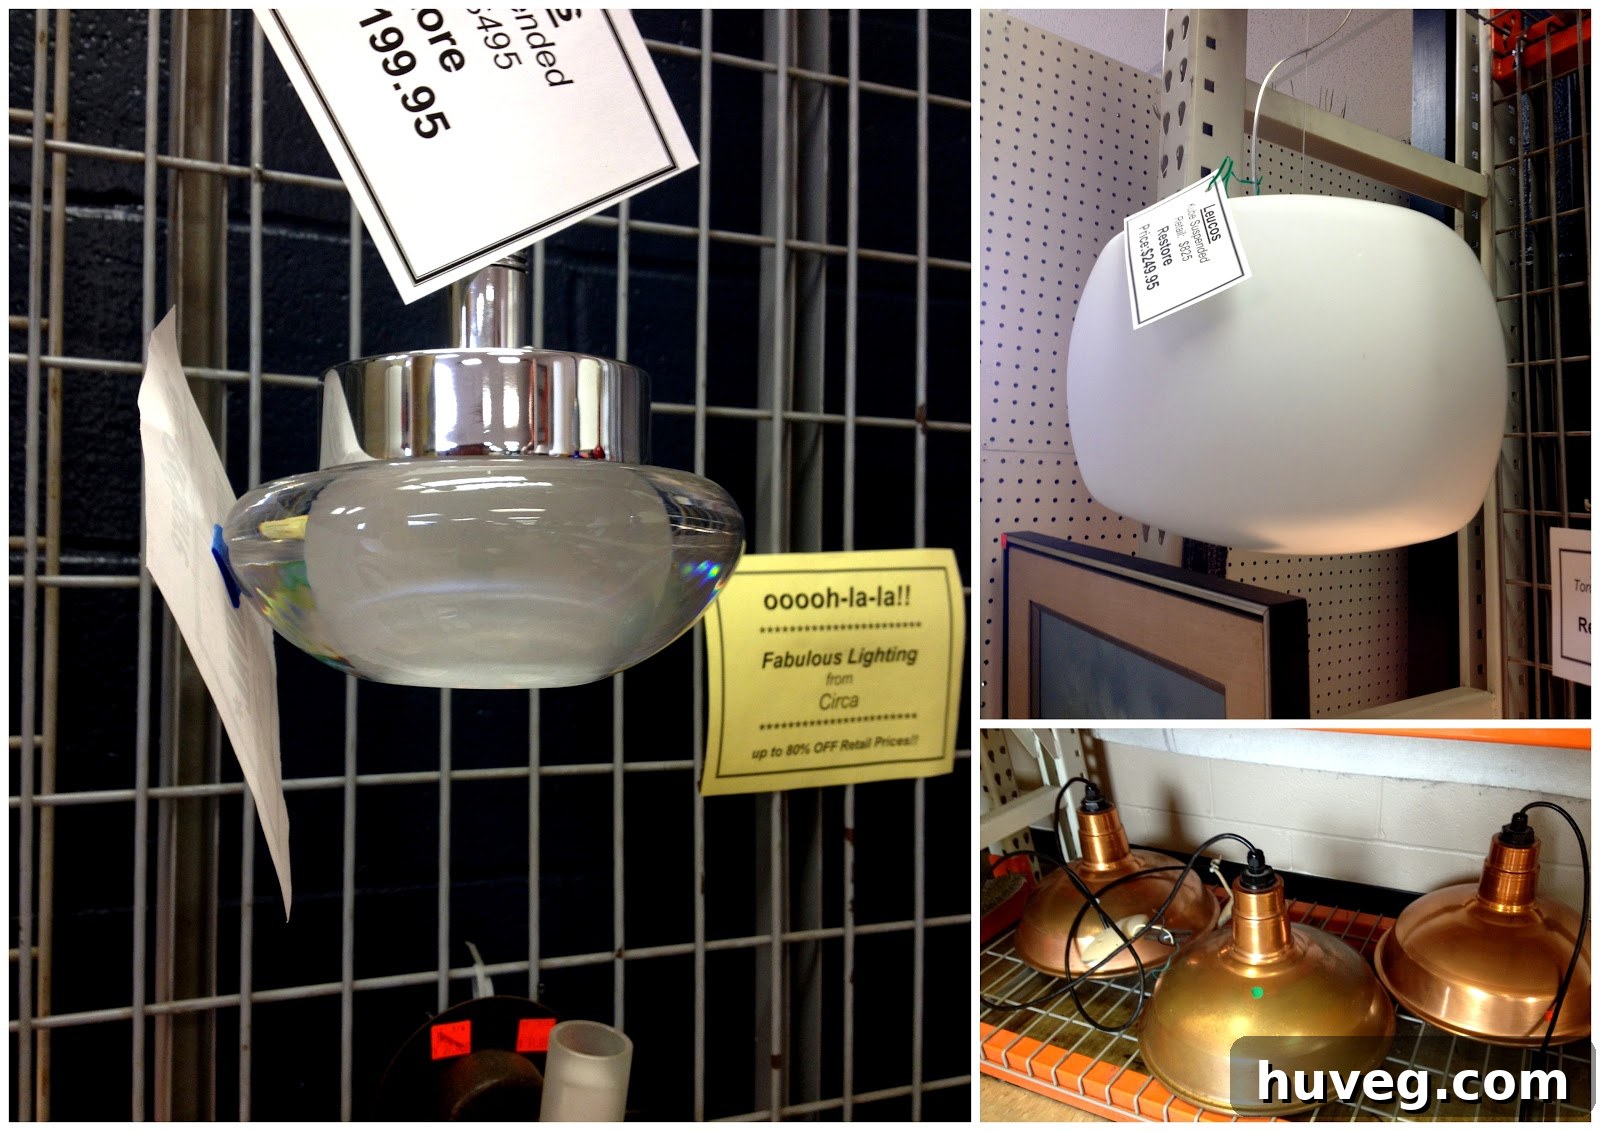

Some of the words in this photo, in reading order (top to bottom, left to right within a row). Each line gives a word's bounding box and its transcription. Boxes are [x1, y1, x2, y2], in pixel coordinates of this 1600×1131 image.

[411, 9, 465, 72] ore
[511, 9, 574, 86] nded
[1203, 204, 1221, 241] Leucos
[1157, 226, 1172, 266] Restore
[1179, 241, 1192, 261] $825
[1190, 220, 1210, 263] Suspended
[764, 584, 911, 611] ooooh-la-la!!
[761, 650, 843, 669] Fabulous
[847, 646, 919, 668] Lighting
[825, 672, 853, 686] from
[819, 692, 860, 711] Circa
[752, 748, 768, 761] up
[770, 747, 783, 757] to
[786, 743, 811, 756] 80%
[813, 740, 838, 753] OFF
[840, 737, 872, 751] Retail
